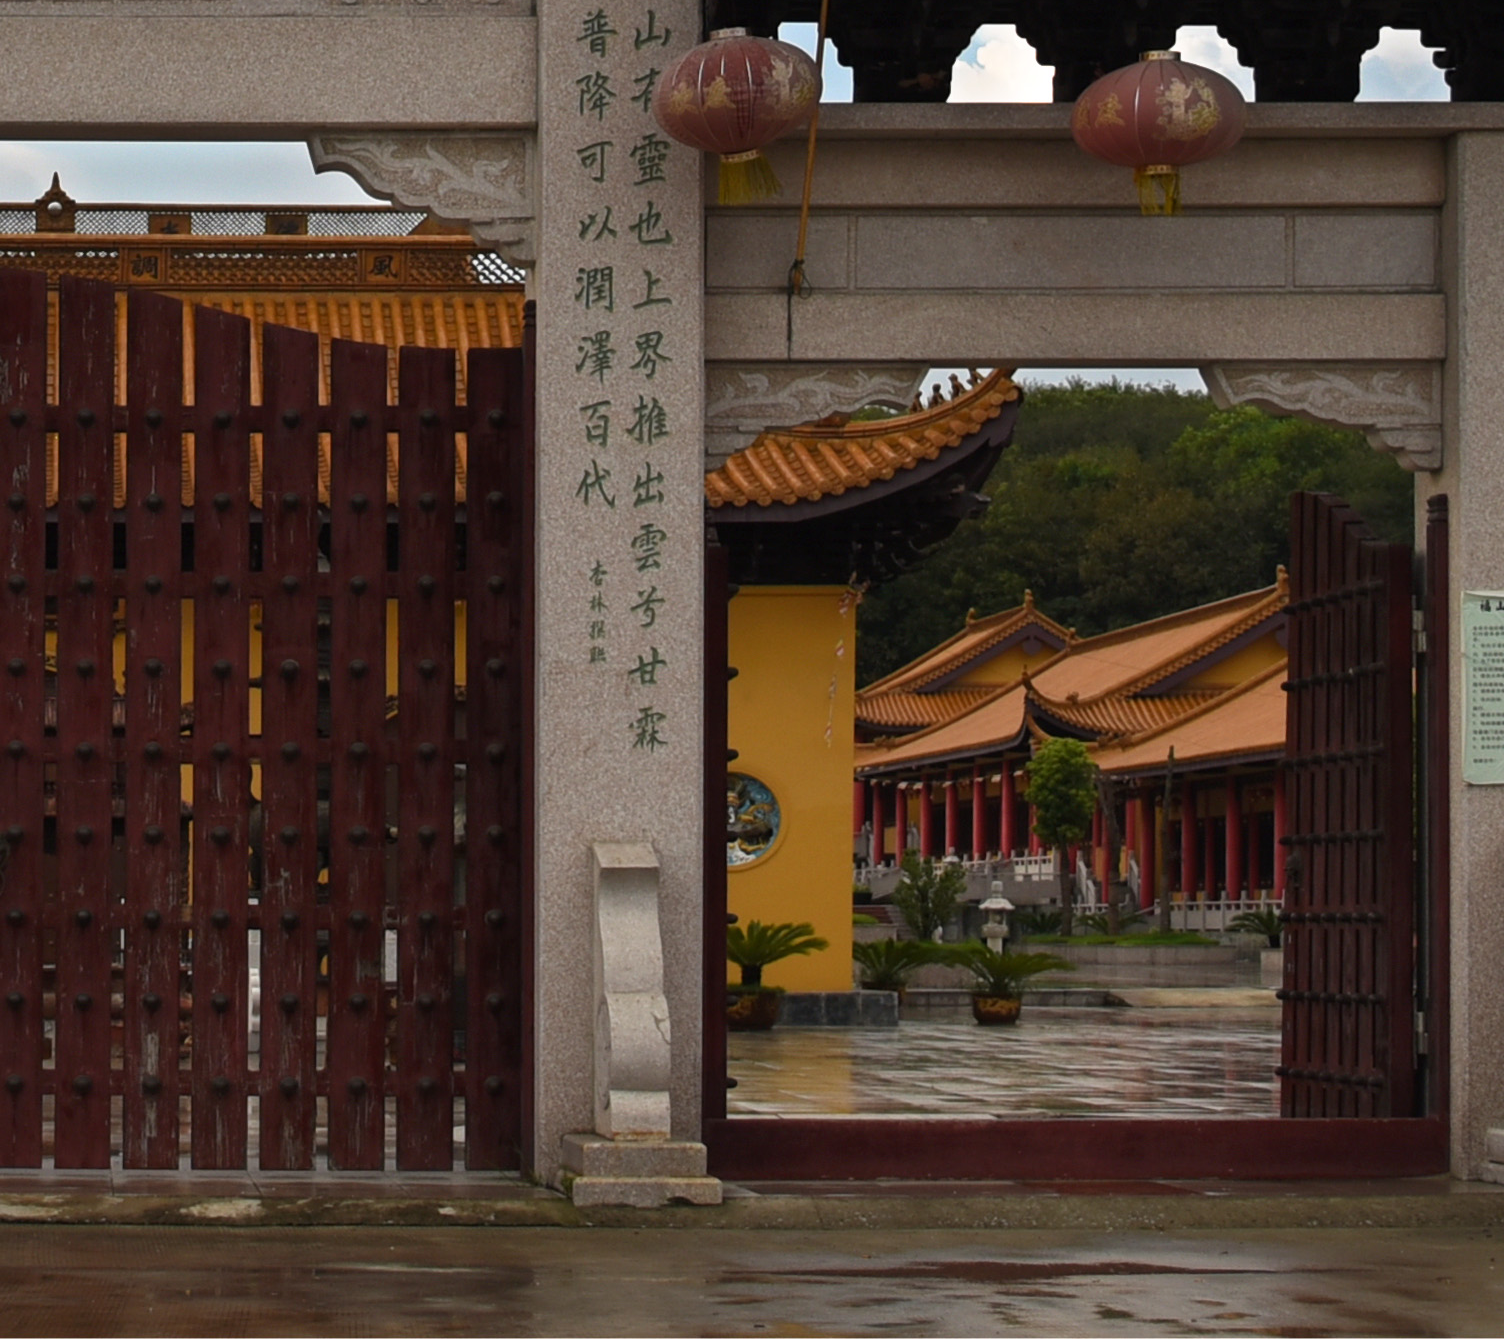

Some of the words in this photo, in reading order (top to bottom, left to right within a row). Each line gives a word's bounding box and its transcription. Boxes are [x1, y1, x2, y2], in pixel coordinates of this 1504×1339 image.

[575, 8, 618, 509] 普降可以潤澤百代
